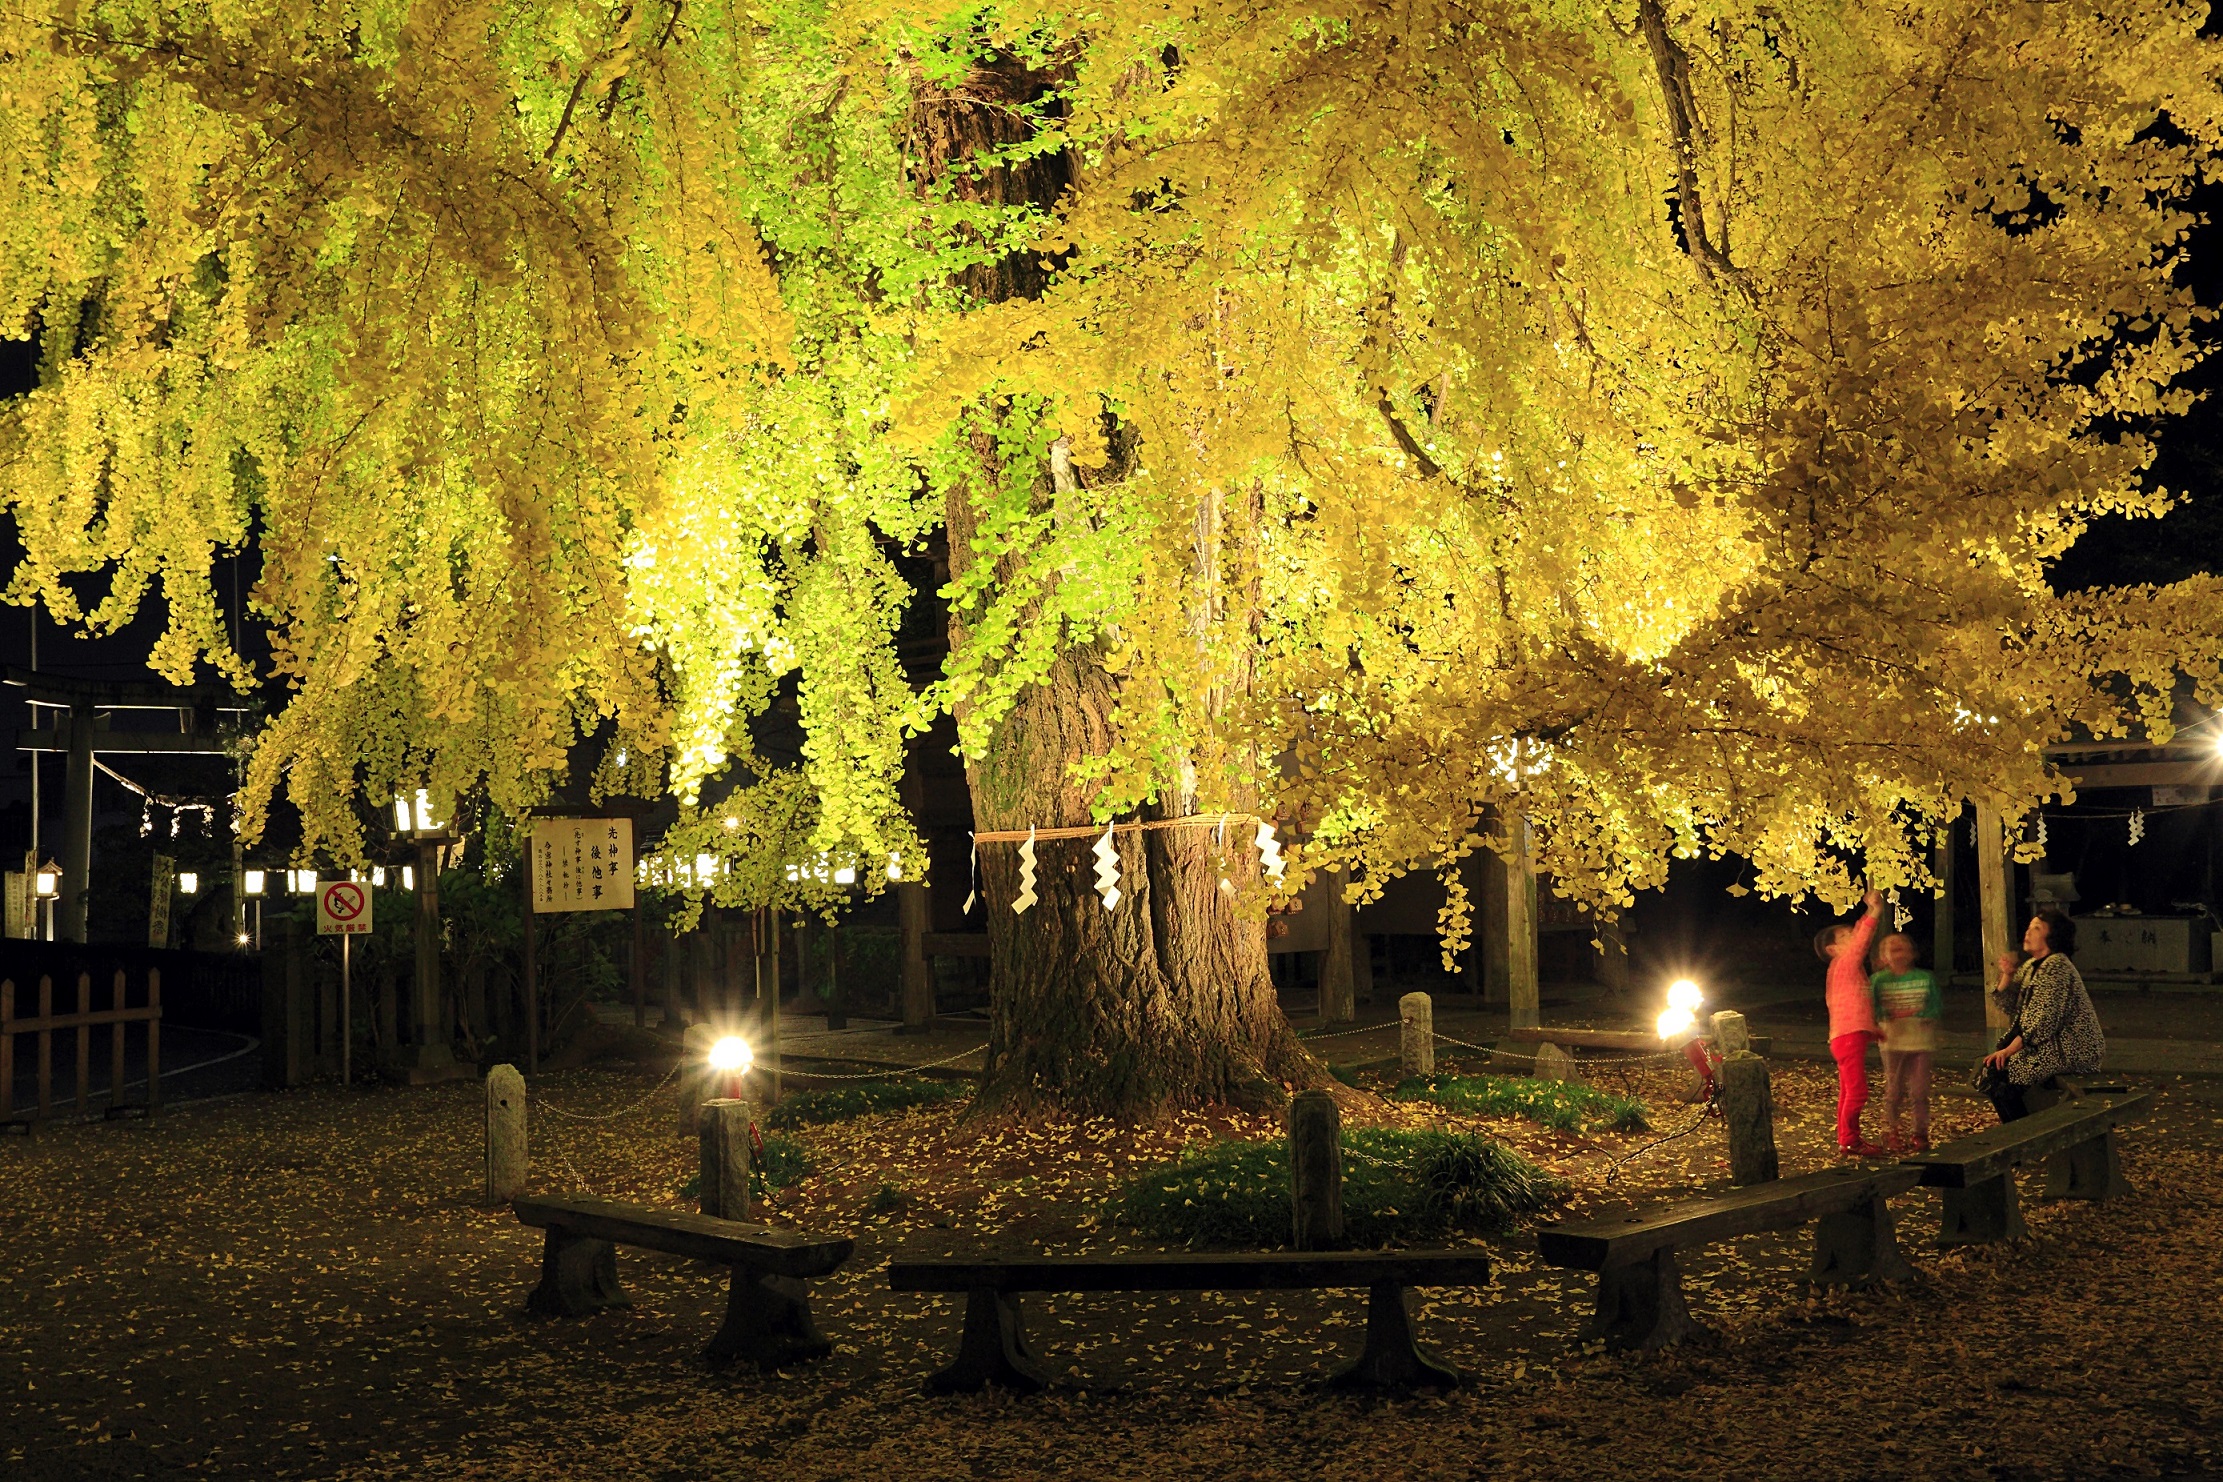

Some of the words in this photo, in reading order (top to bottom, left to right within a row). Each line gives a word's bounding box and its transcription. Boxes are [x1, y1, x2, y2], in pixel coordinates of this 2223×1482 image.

[591, 845, 603, 900] 後他事
[608, 826, 618, 876] 先神事
[323, 923, 367, 933] 火気厳禁
